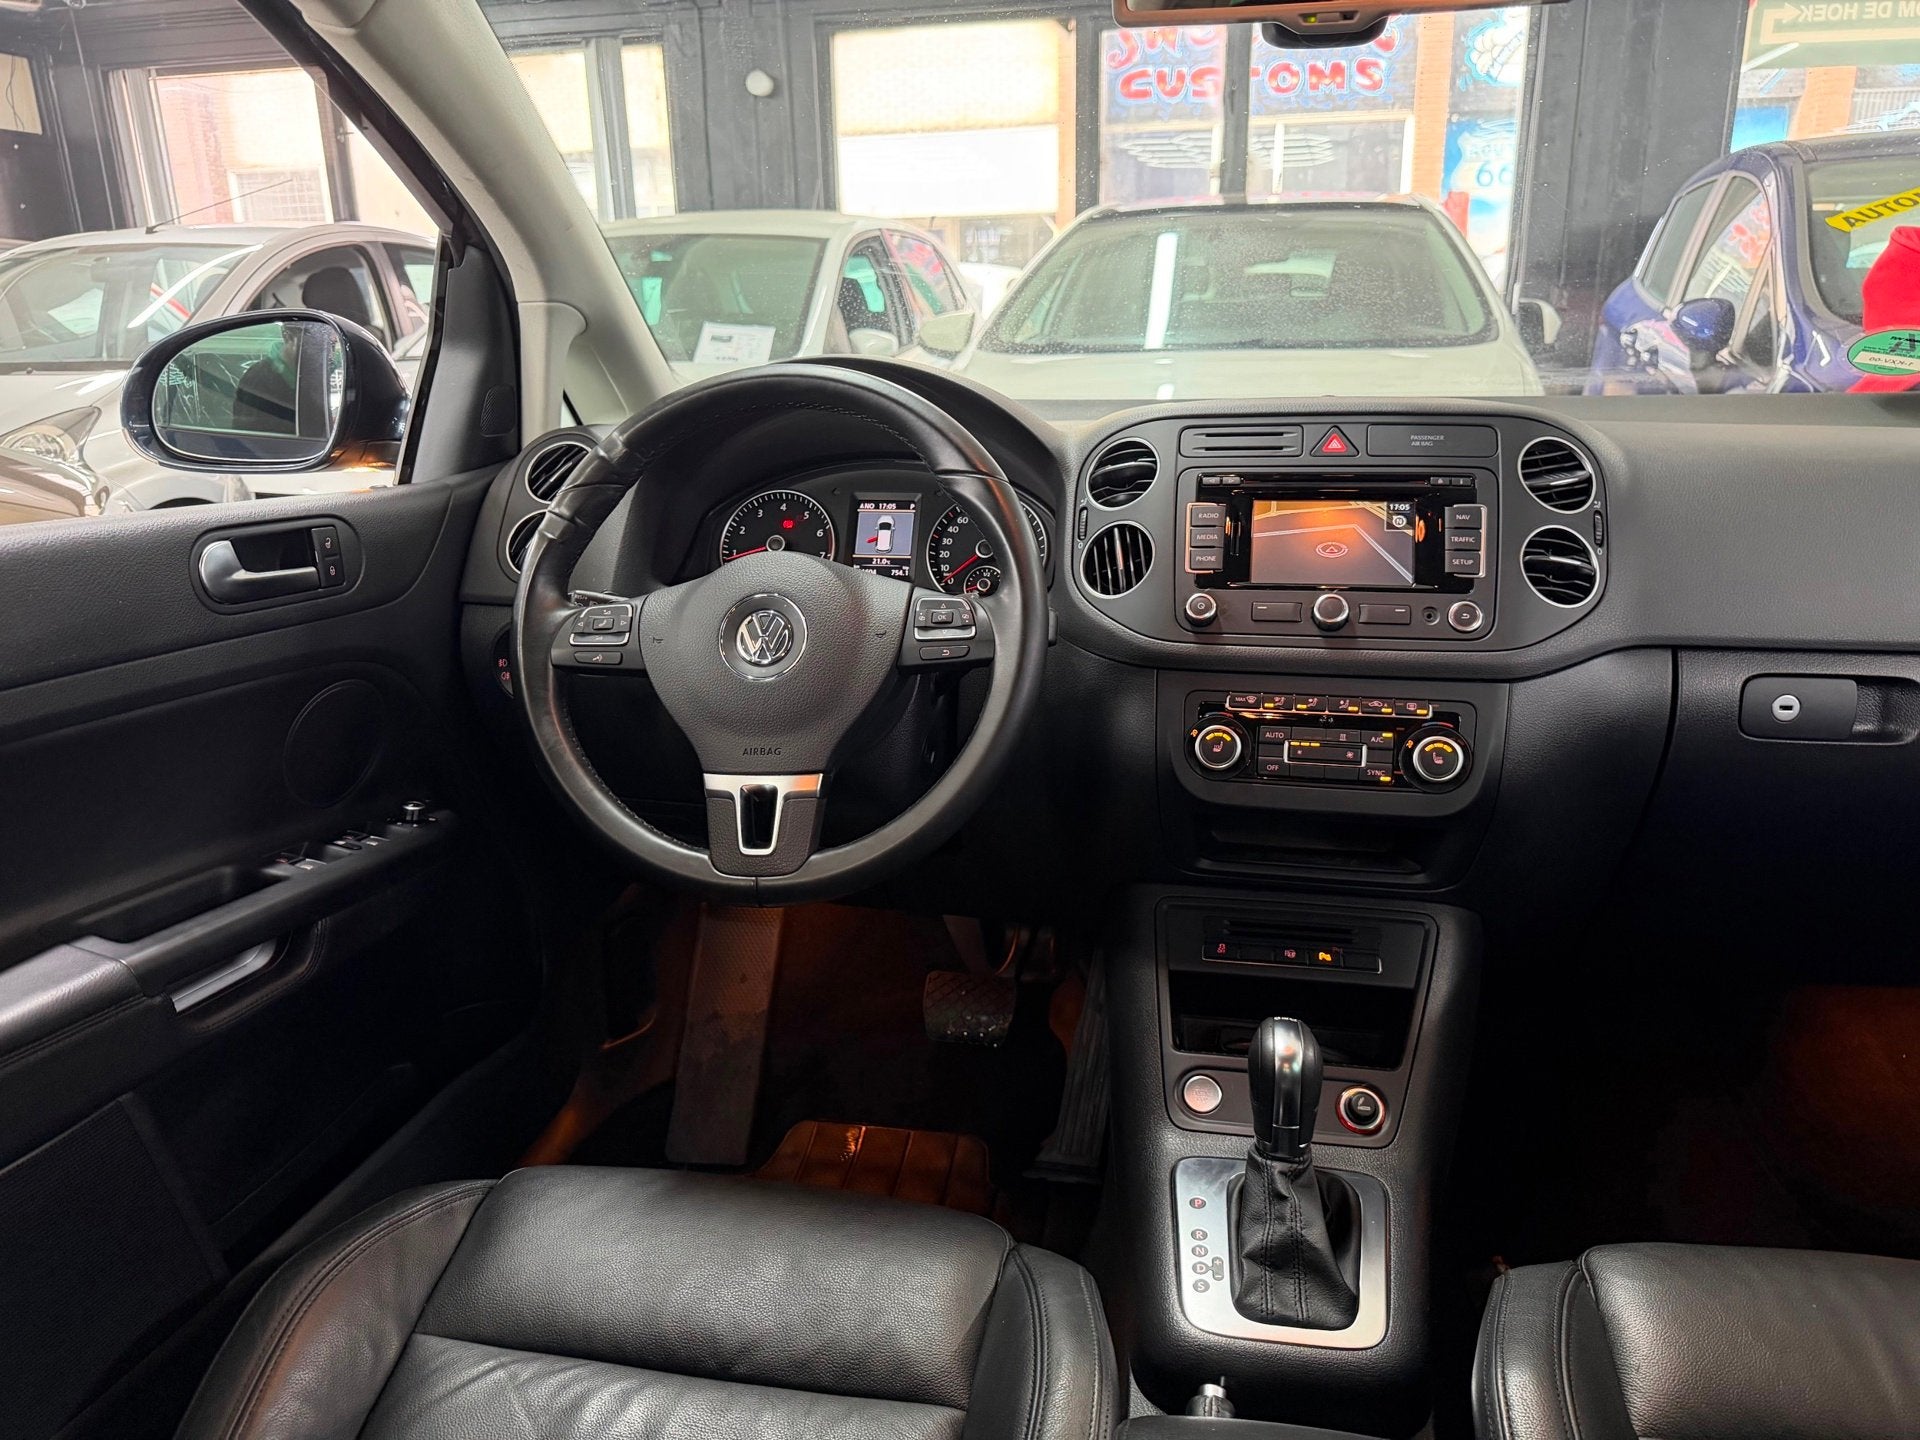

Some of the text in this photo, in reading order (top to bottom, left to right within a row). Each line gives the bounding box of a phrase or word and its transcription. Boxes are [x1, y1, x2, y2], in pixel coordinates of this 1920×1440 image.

[1842, 192, 1920, 228] AUTO
[780, 503, 787, 512] 4
[1389, 503, 1411, 511] 17:05
[757, 509, 763, 518] 3
[803, 511, 810, 520] 5
[957, 516, 969, 524] 60
[739, 526, 746, 535] 2
[816, 529, 824, 537] 6
[819, 551, 827, 559] 7
[941, 564, 950, 572] 10
[743, 747, 782, 756] AIRBAG
[1194, 1199, 1202, 1207] P
[1195, 1231, 1203, 1239] R
[1195, 1247, 1205, 1255] N
[1196, 1264, 1206, 1272] D
[1197, 1282, 1205, 1291] S
